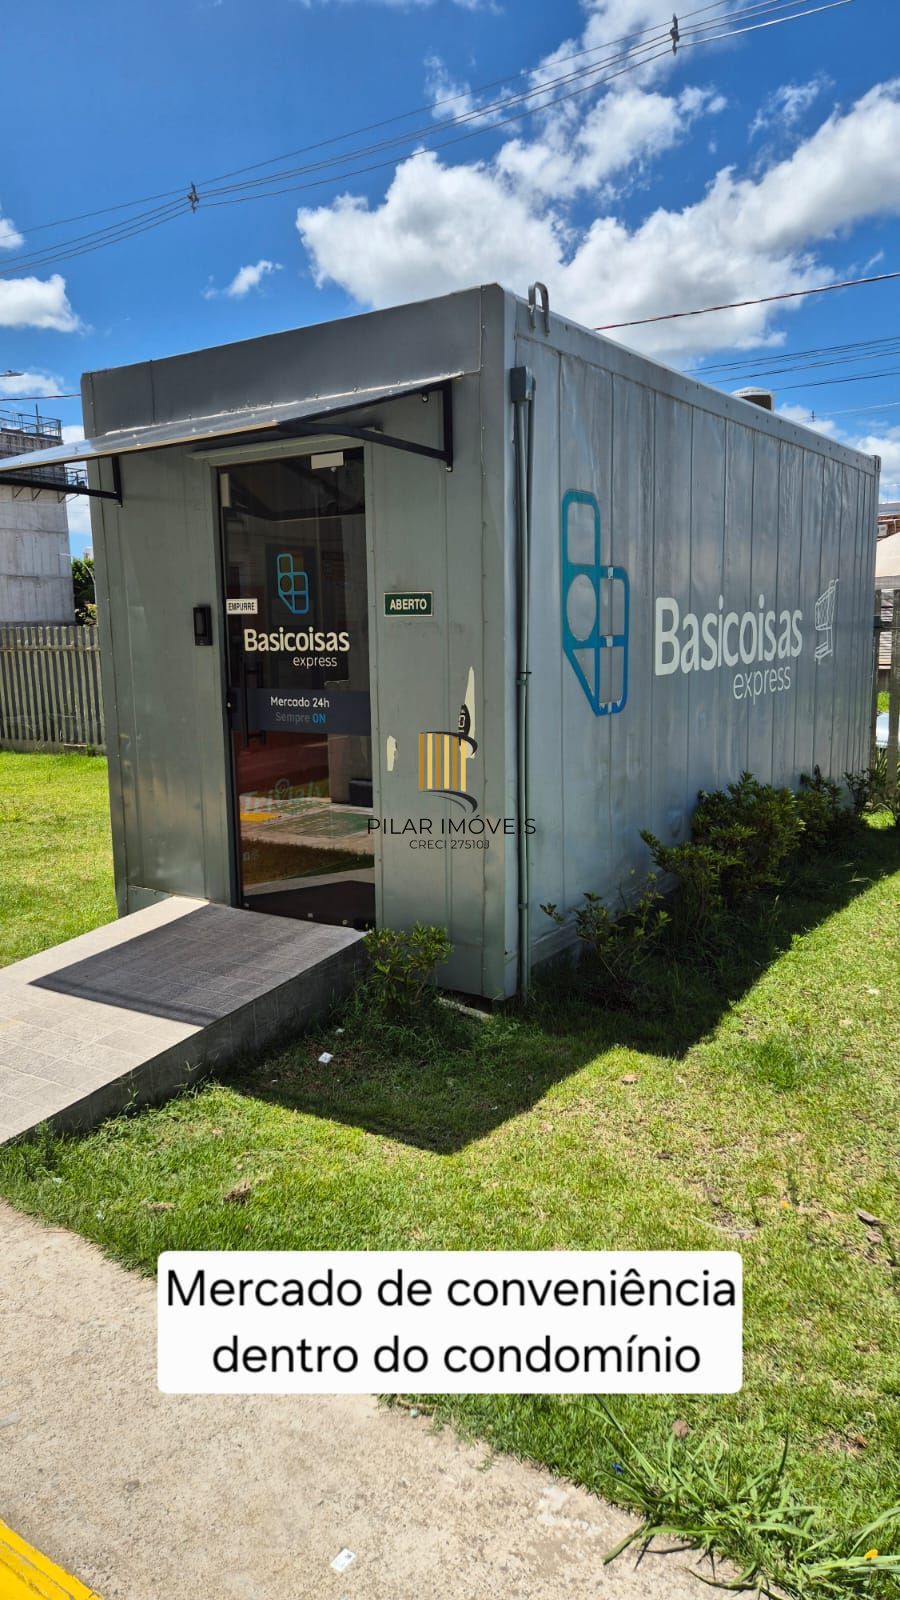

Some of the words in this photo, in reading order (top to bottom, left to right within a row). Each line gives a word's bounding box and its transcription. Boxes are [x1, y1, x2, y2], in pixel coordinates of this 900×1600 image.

[228, 602, 256, 611] EMPURRE
[389, 598, 427, 611] ABERTO
[243, 626, 350, 652] Basicoisas
[655, 594, 803, 676] Basicoisas
[292, 655, 338, 669] express
[733, 666, 791, 704] express
[270, 696, 310, 707] Mercado
[312, 697, 330, 708] 24h
[275, 711, 310, 725] Sempre
[312, 712, 327, 724] ON
